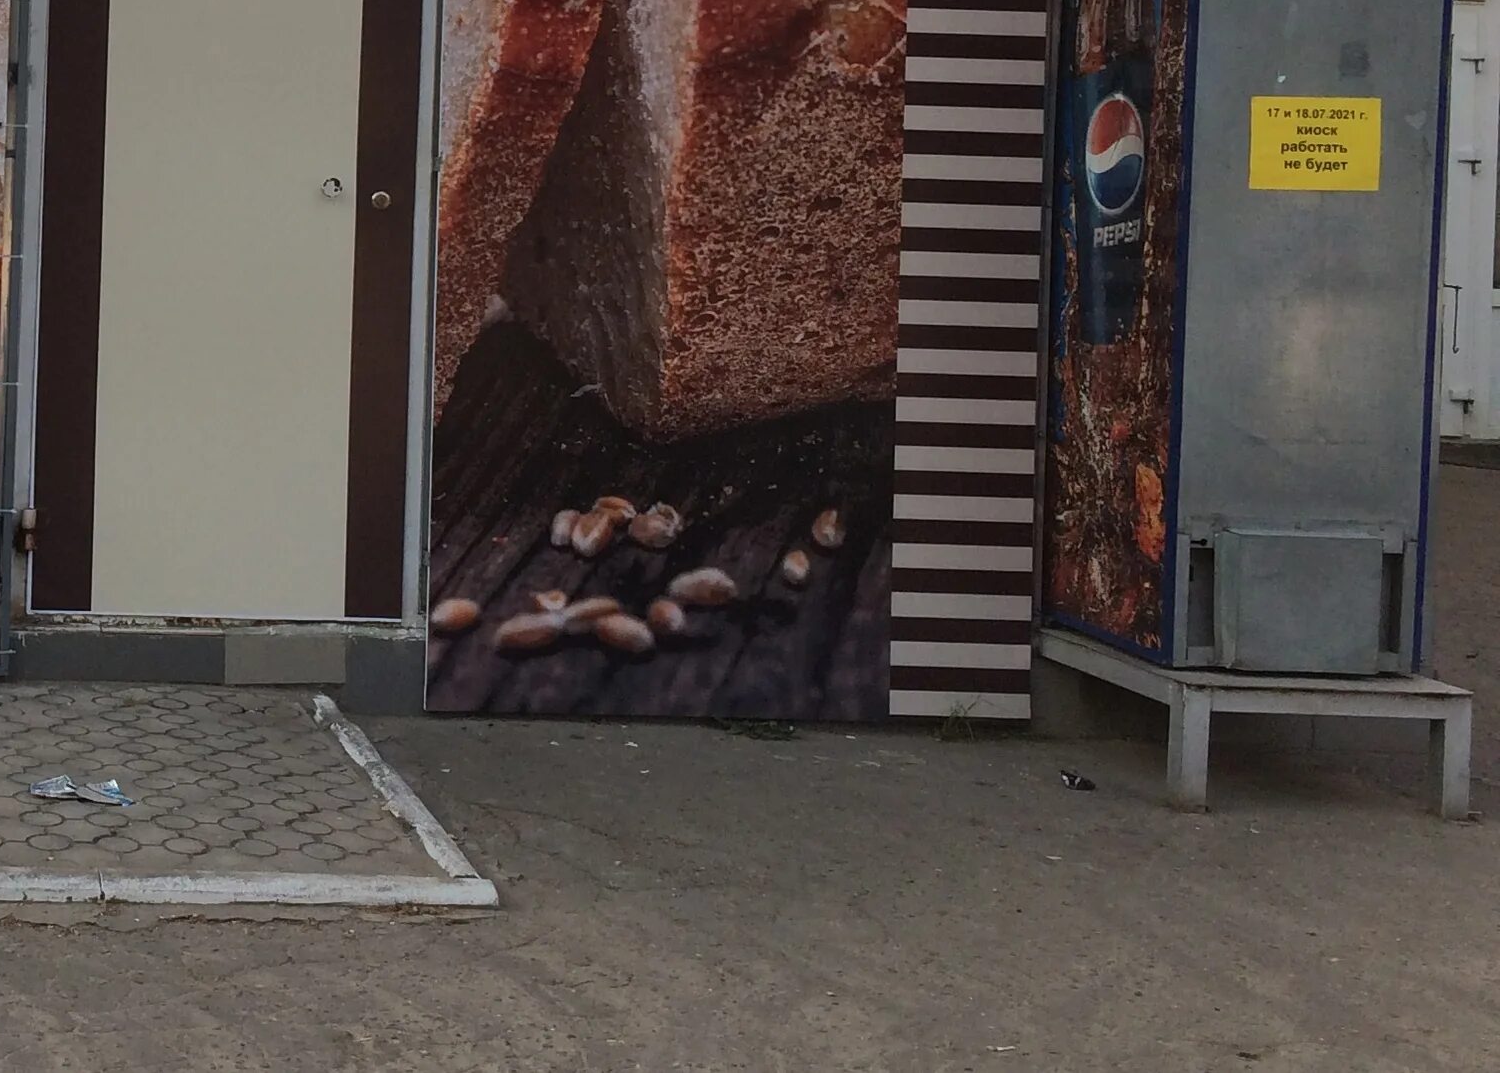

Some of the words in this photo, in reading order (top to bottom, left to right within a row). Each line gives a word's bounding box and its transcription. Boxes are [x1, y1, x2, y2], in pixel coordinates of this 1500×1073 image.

[1267, 108, 1280, 118] 17
[1284, 110, 1291, 118] и
[1296, 109, 1355, 120] 18.07.2021
[1359, 111, 1368, 120] г.
[1297, 125, 1338, 136] киоск
[1280, 141, 1348, 154] работать
[1284, 159, 1301, 170] не
[1306, 158, 1348, 173] будет
[1093, 219, 1141, 249] PEPSI
